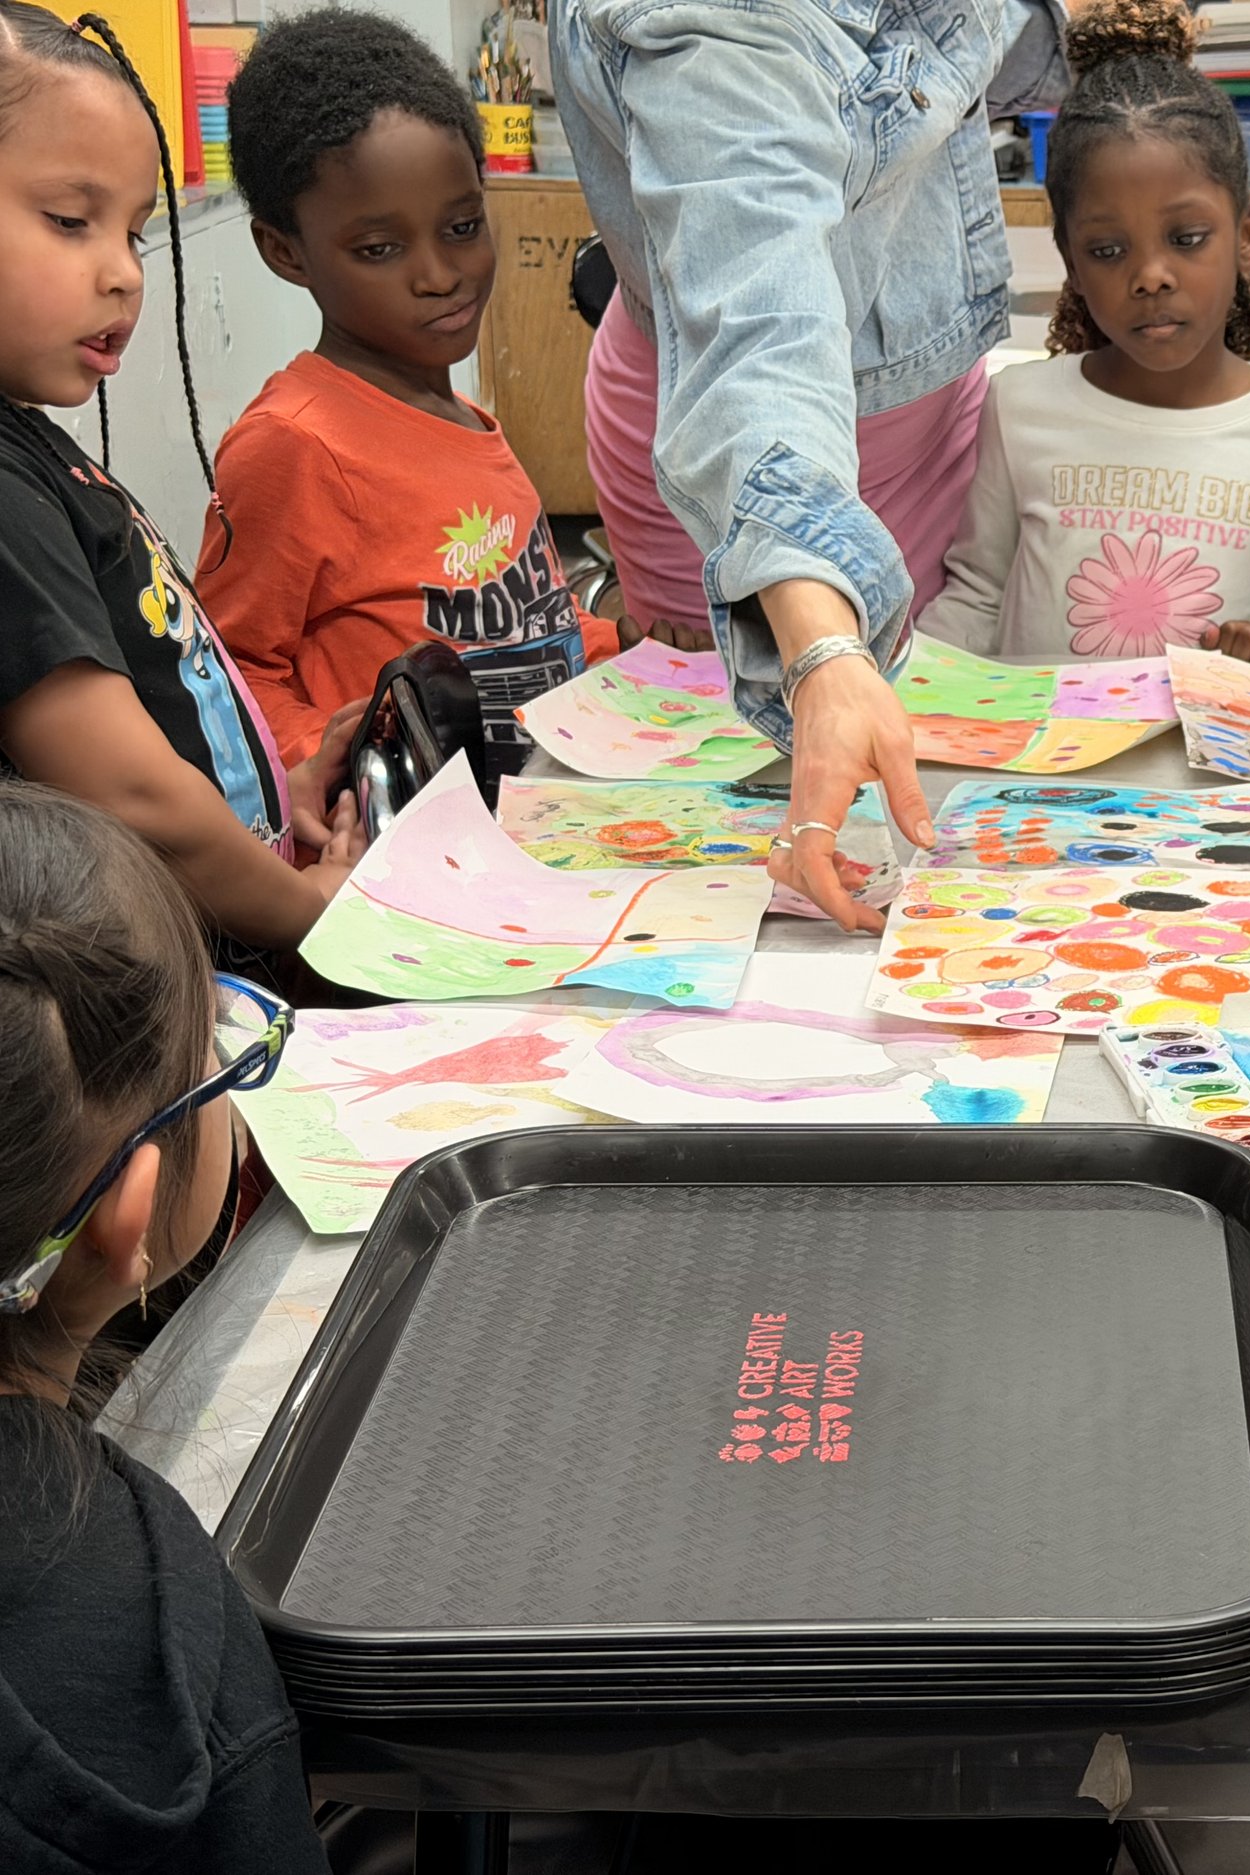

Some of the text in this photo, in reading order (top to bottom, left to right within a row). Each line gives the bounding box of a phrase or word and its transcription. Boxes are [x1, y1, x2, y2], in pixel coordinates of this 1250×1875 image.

[518, 235, 585, 268] EV
[1052, 464, 1189, 513] DREAM
[443, 513, 516, 581] Racing
[1059, 508, 1250, 550] STAY POSITIVE
[737, 1313, 788, 1399] CREATIVE
[779, 1360, 819, 1399] ART
[821, 1331, 864, 1398] WORKS
